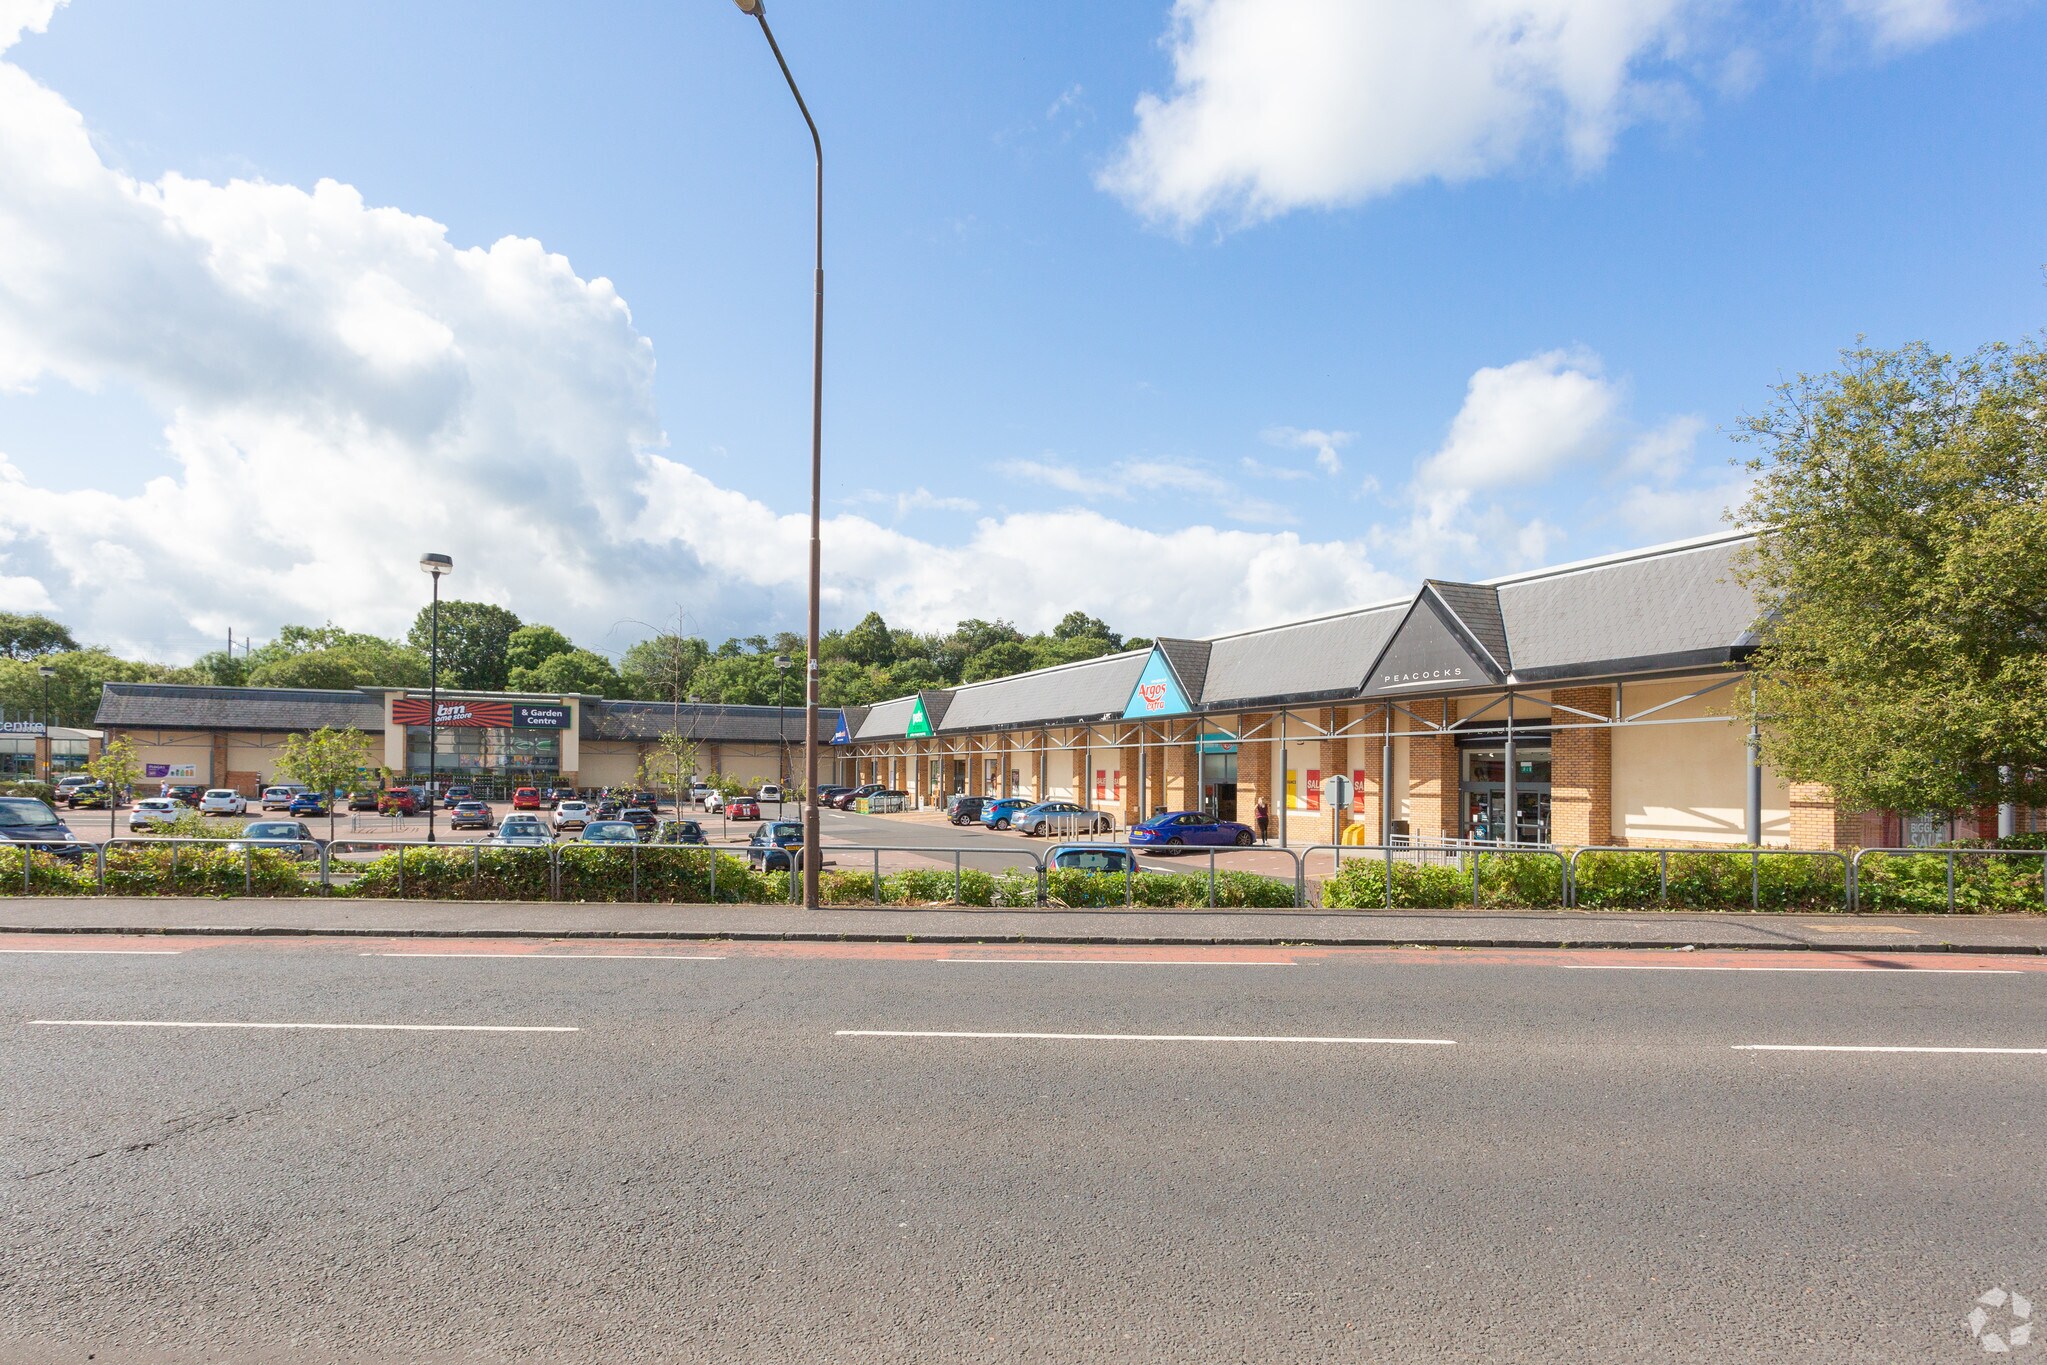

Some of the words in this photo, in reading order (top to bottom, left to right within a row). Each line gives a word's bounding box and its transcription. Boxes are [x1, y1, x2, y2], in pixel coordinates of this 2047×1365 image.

[1384, 668, 1462, 683] PEACOCKS
[1138, 683, 1166, 700] Argos
[1146, 702, 1165, 711] extra
[433, 715, 453, 723] ome
[453, 712, 473, 721] store
[530, 709, 563, 718] Garden
[527, 717, 557, 725] Centre
[1307, 779, 1320, 789] SAL
[1911, 833, 1943, 847] SALE
